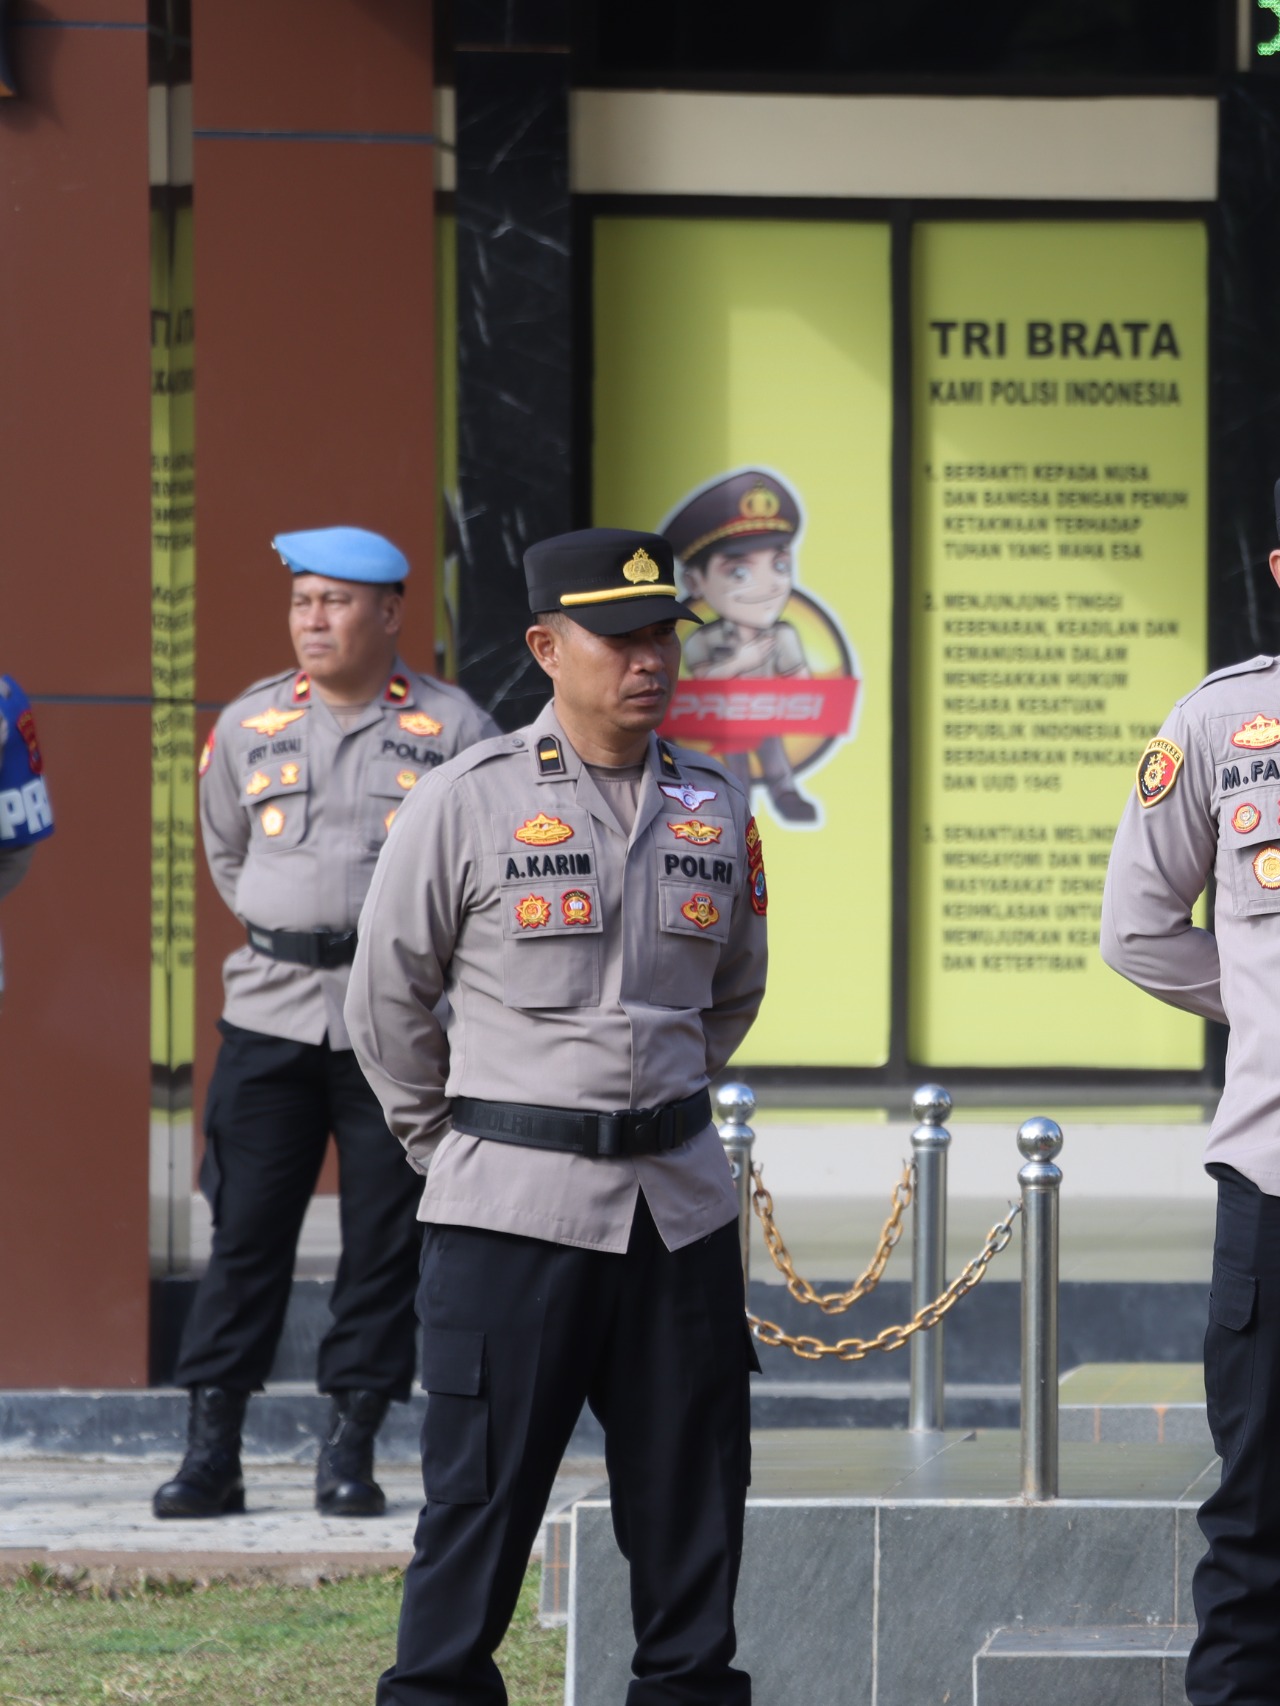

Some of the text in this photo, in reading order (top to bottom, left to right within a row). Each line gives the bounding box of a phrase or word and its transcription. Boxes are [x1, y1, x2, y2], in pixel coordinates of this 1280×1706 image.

[930, 320, 1181, 360] TRI BRATA
[929, 377, 1181, 406] KAMI POLISI INDONESIA
[1033, 464, 1098, 482] KEPADA
[944, 490, 977, 508] DAN
[983, 490, 1050, 508] BANGSA
[1057, 490, 1125, 508] DENGAN
[1007, 542, 1051, 560] YANG
[1111, 542, 1142, 560] ESA
[1145, 619, 1179, 637] DAN
[670, 693, 825, 721] PRESISI
[381, 740, 444, 767] POLRI
[1152, 741, 1181, 760] RESERSE
[944, 774, 977, 792] DAN
[505, 853, 591, 880] A.KARIM
[664, 853, 733, 884] POLRI
